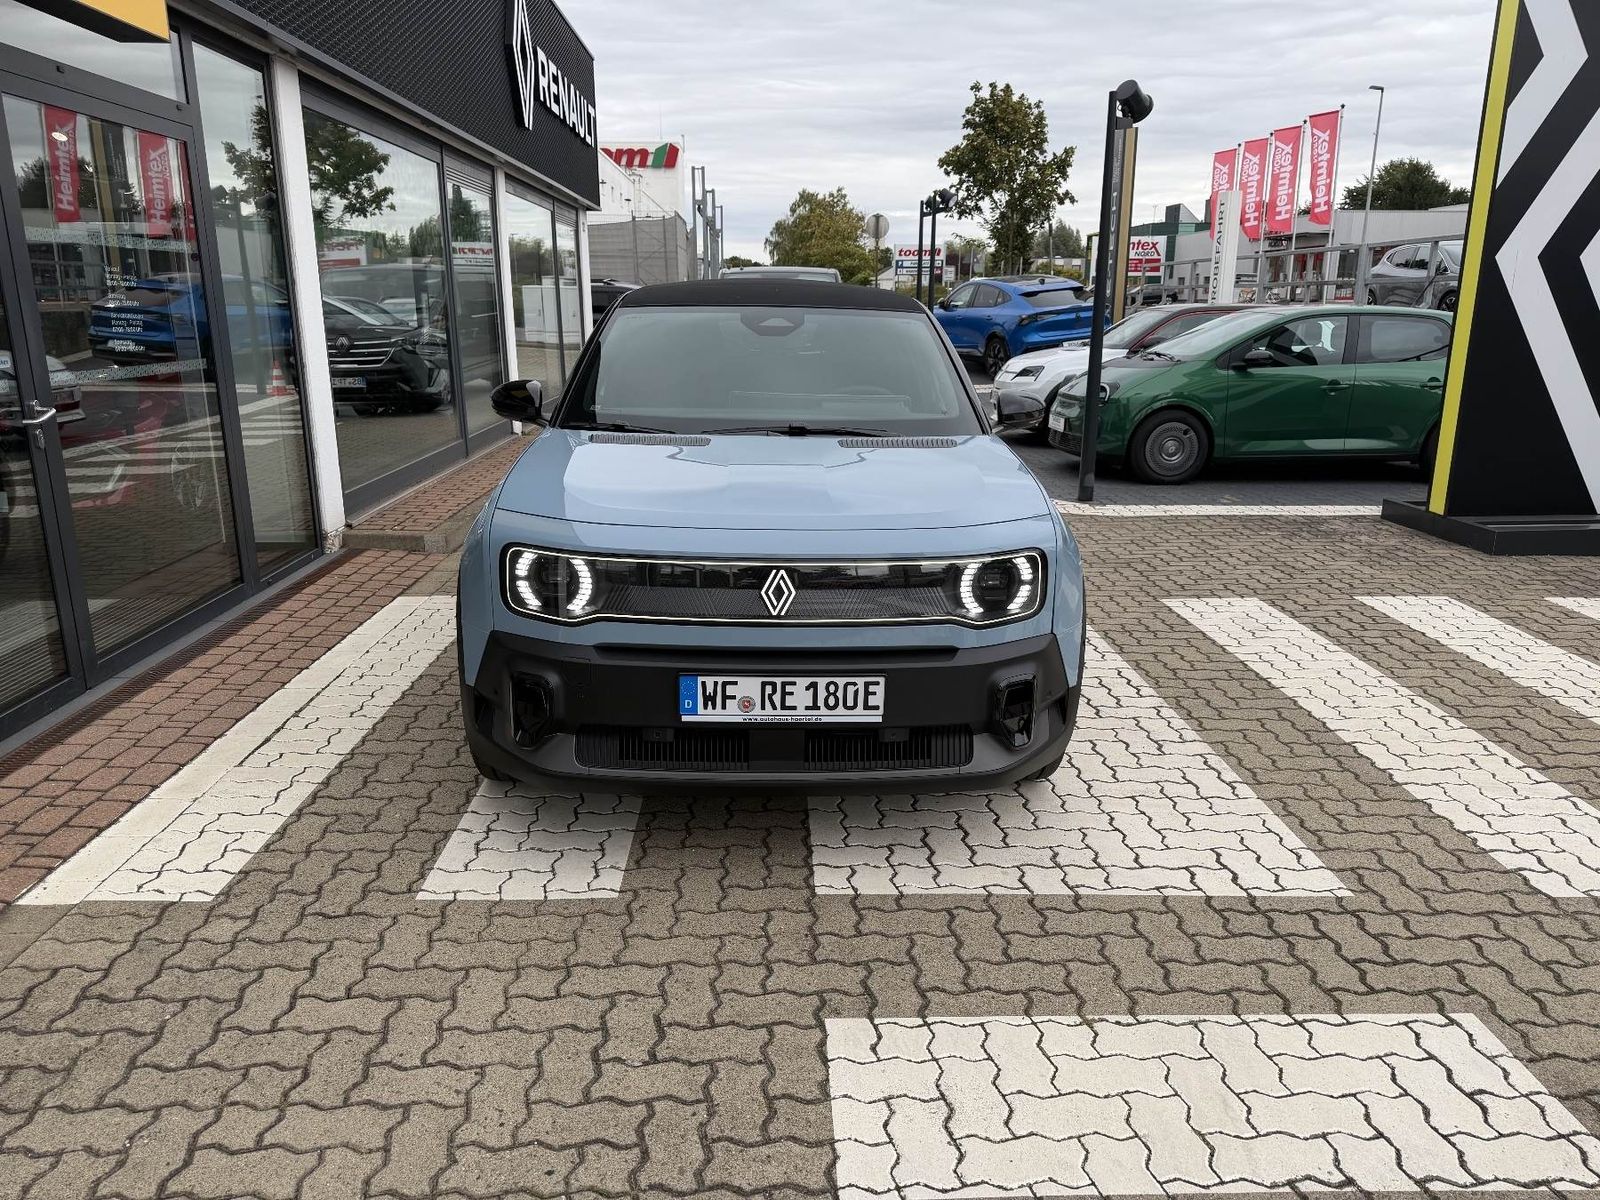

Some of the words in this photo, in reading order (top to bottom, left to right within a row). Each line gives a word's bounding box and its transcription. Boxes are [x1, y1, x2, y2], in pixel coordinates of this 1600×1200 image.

[536, 46, 596, 148] RENAULT
[148, 144, 169, 225] Heimtex
[684, 699, 692, 709] D
[700, 680, 738, 711] WF
[760, 680, 797, 711] RE
[804, 680, 880, 711] 180E
